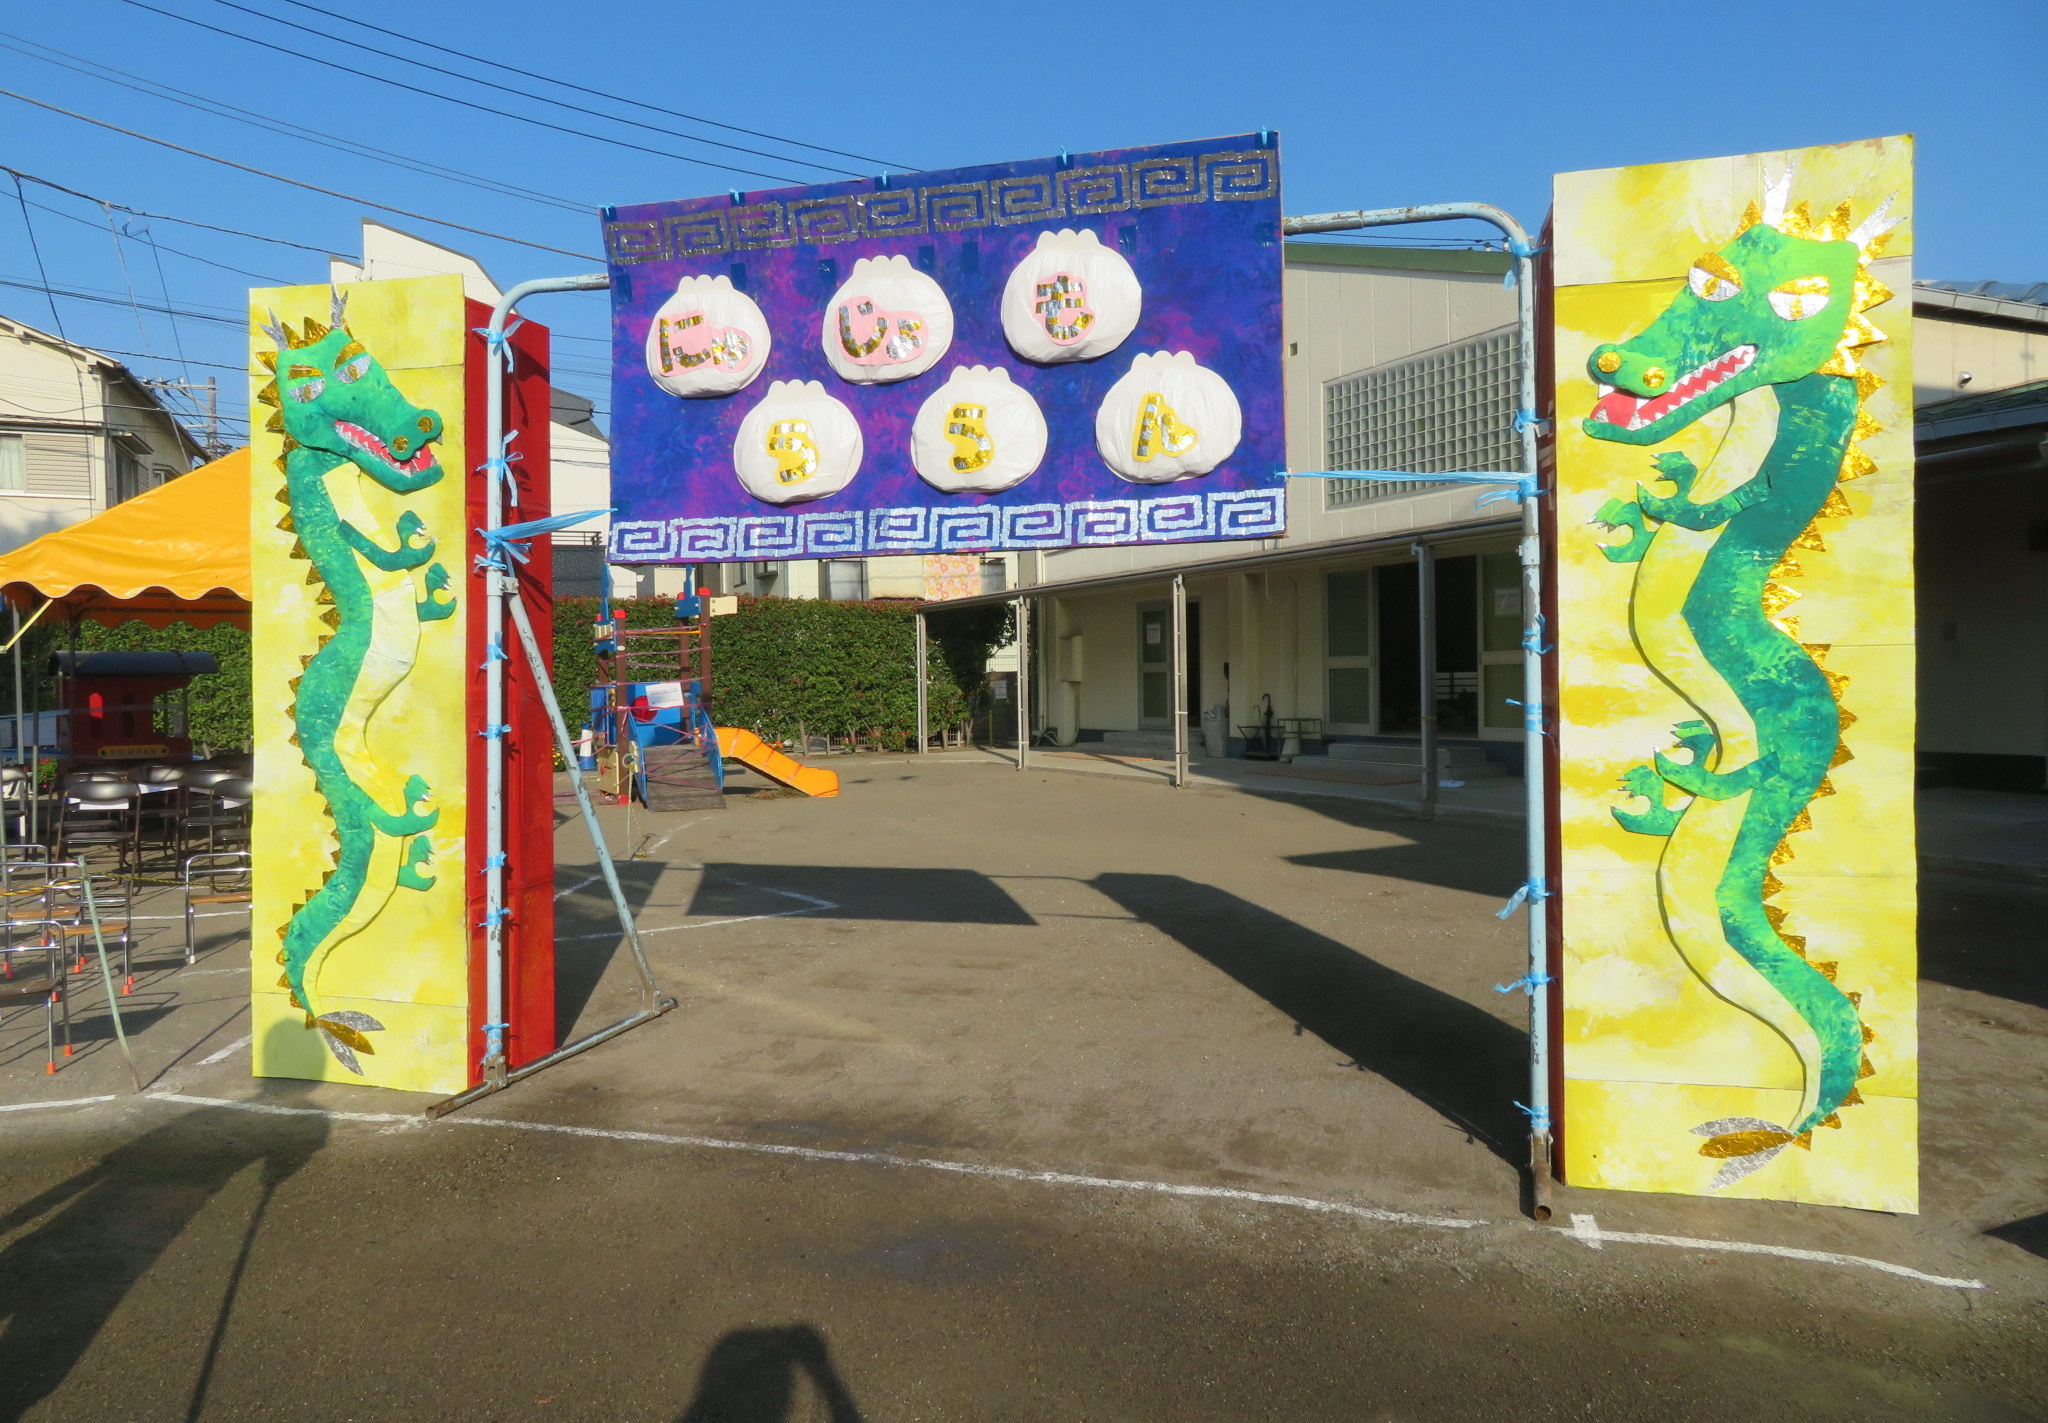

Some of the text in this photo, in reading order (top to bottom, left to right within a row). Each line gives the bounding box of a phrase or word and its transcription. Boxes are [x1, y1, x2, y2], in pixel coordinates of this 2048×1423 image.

[769, 421, 818, 483] う
[948, 407, 992, 471] う
[1035, 275, 1094, 340] も
[1137, 395, 1196, 457] ん
